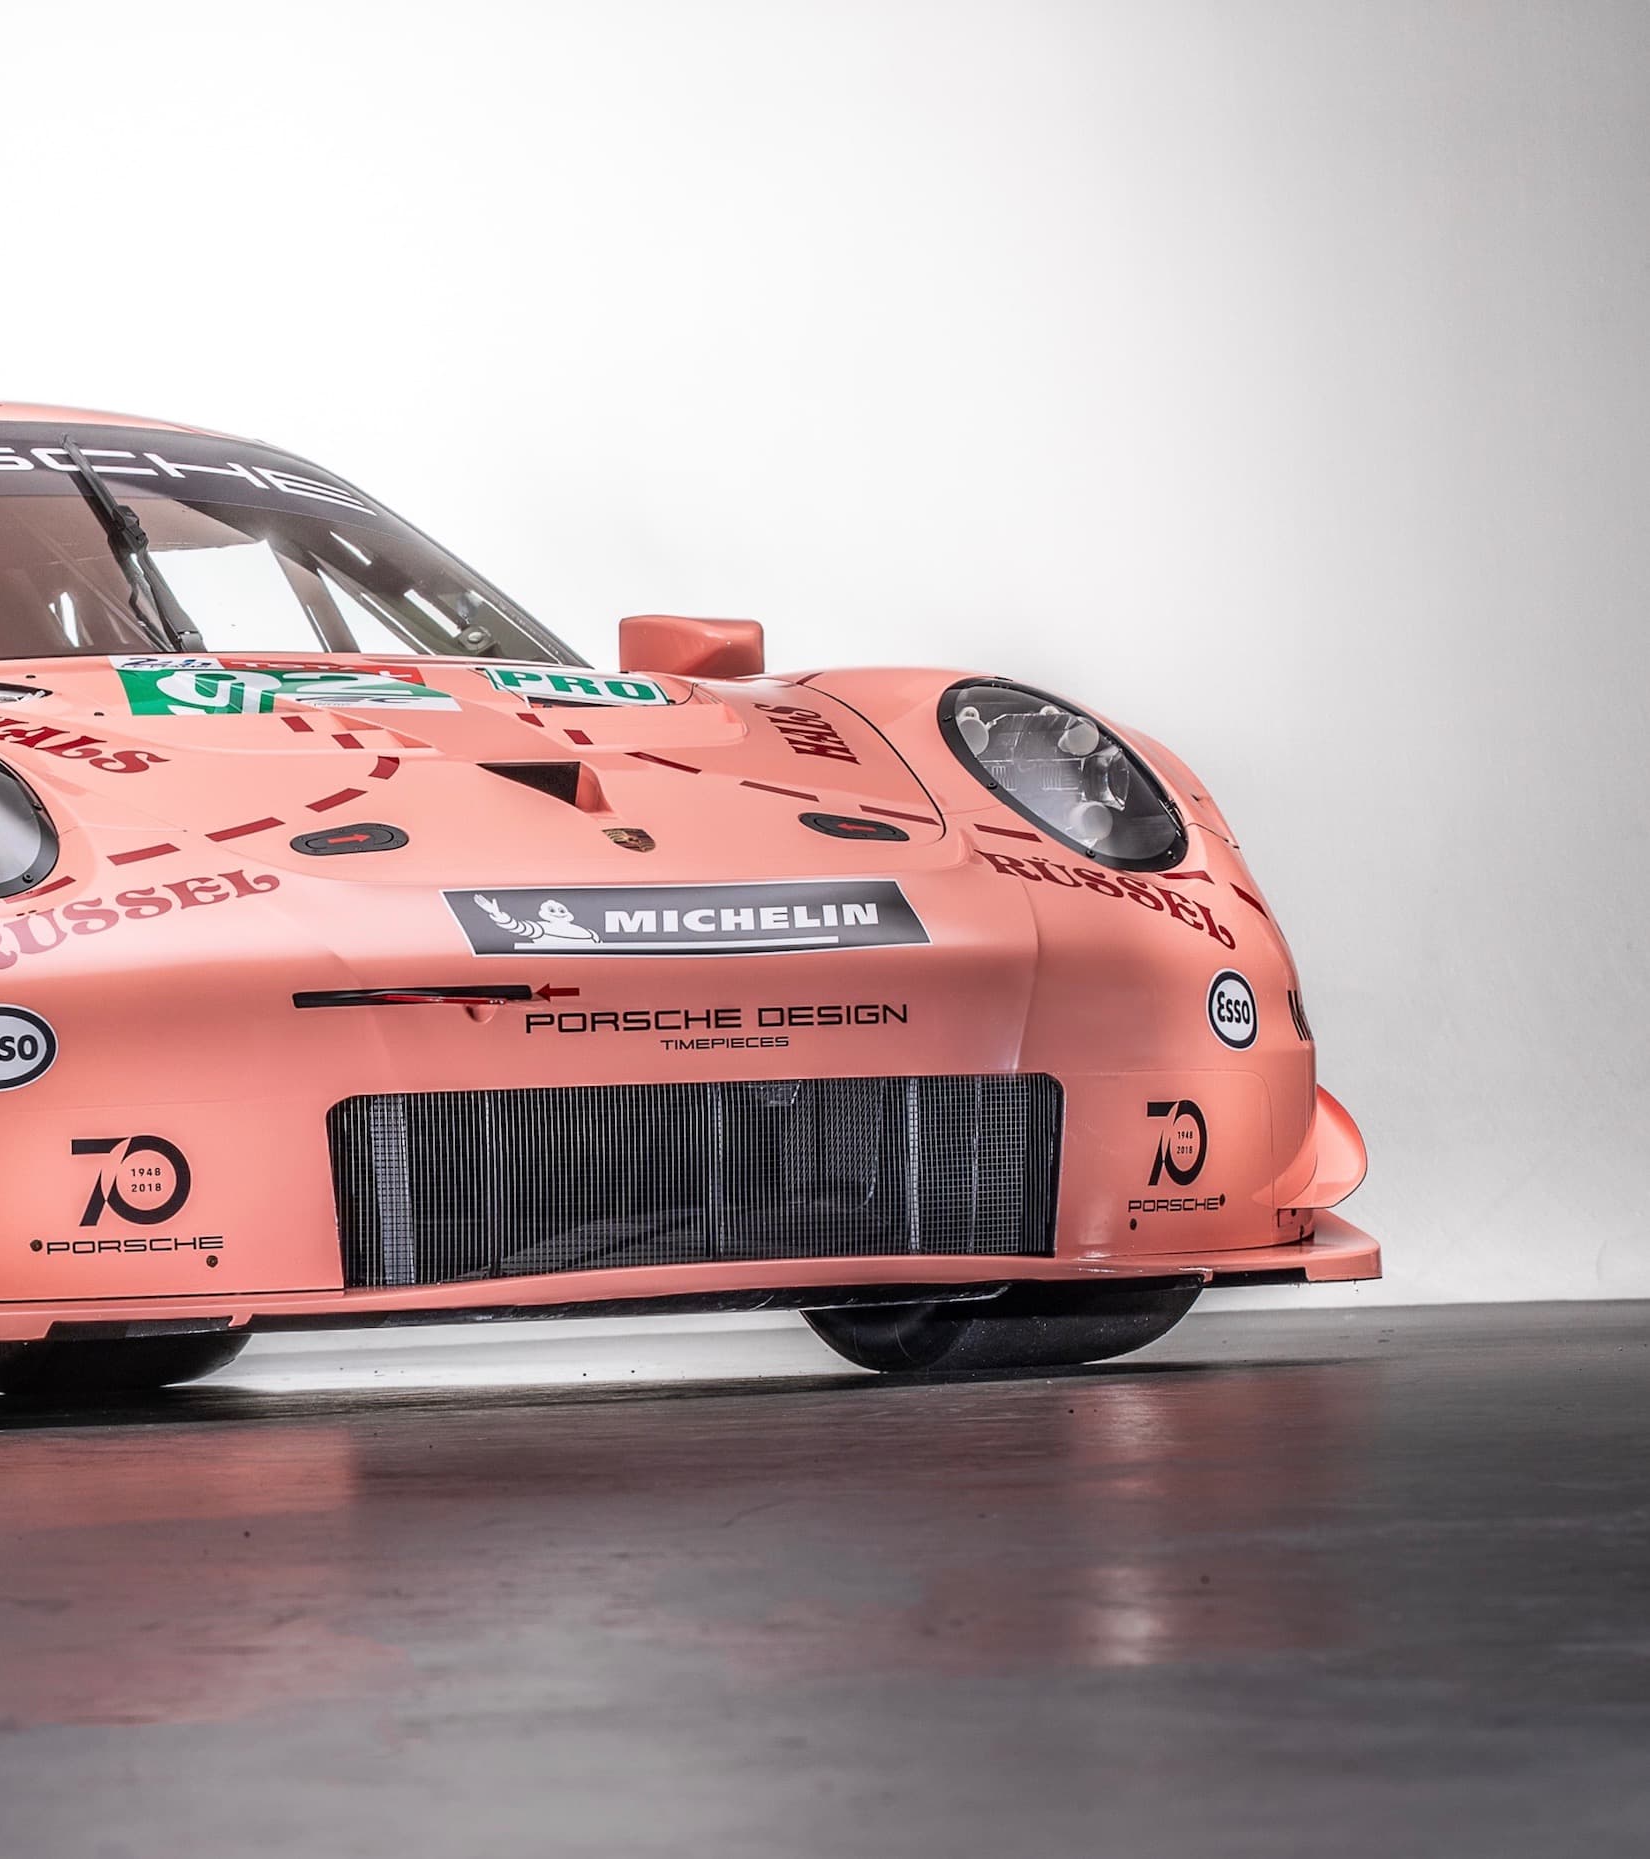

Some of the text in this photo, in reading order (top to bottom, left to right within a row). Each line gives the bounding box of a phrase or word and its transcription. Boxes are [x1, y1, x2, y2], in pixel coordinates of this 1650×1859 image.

[155, 670, 414, 715] 92
[495, 668, 657, 701] PRO
[751, 702, 862, 766] HALS
[974, 849, 1236, 951] RÜSSEL
[604, 902, 881, 934] MICHELIN
[525, 1003, 909, 1034] PORSCHE DESIGN
[1216, 990, 1251, 1026] Esso
[660, 1036, 790, 1051] TIMEPIECES
[1147, 1099, 1208, 1186] 70
[1176, 1145, 1193, 1155] 2018
[1177, 1130, 1194, 1140] 1948
[71, 1135, 192, 1227] 70
[130, 1167, 162, 1177] 1948
[130, 1182, 163, 1193] 2018
[1128, 1197, 1220, 1213] PORSCHE
[47, 1235, 224, 1256] PORSCHE
